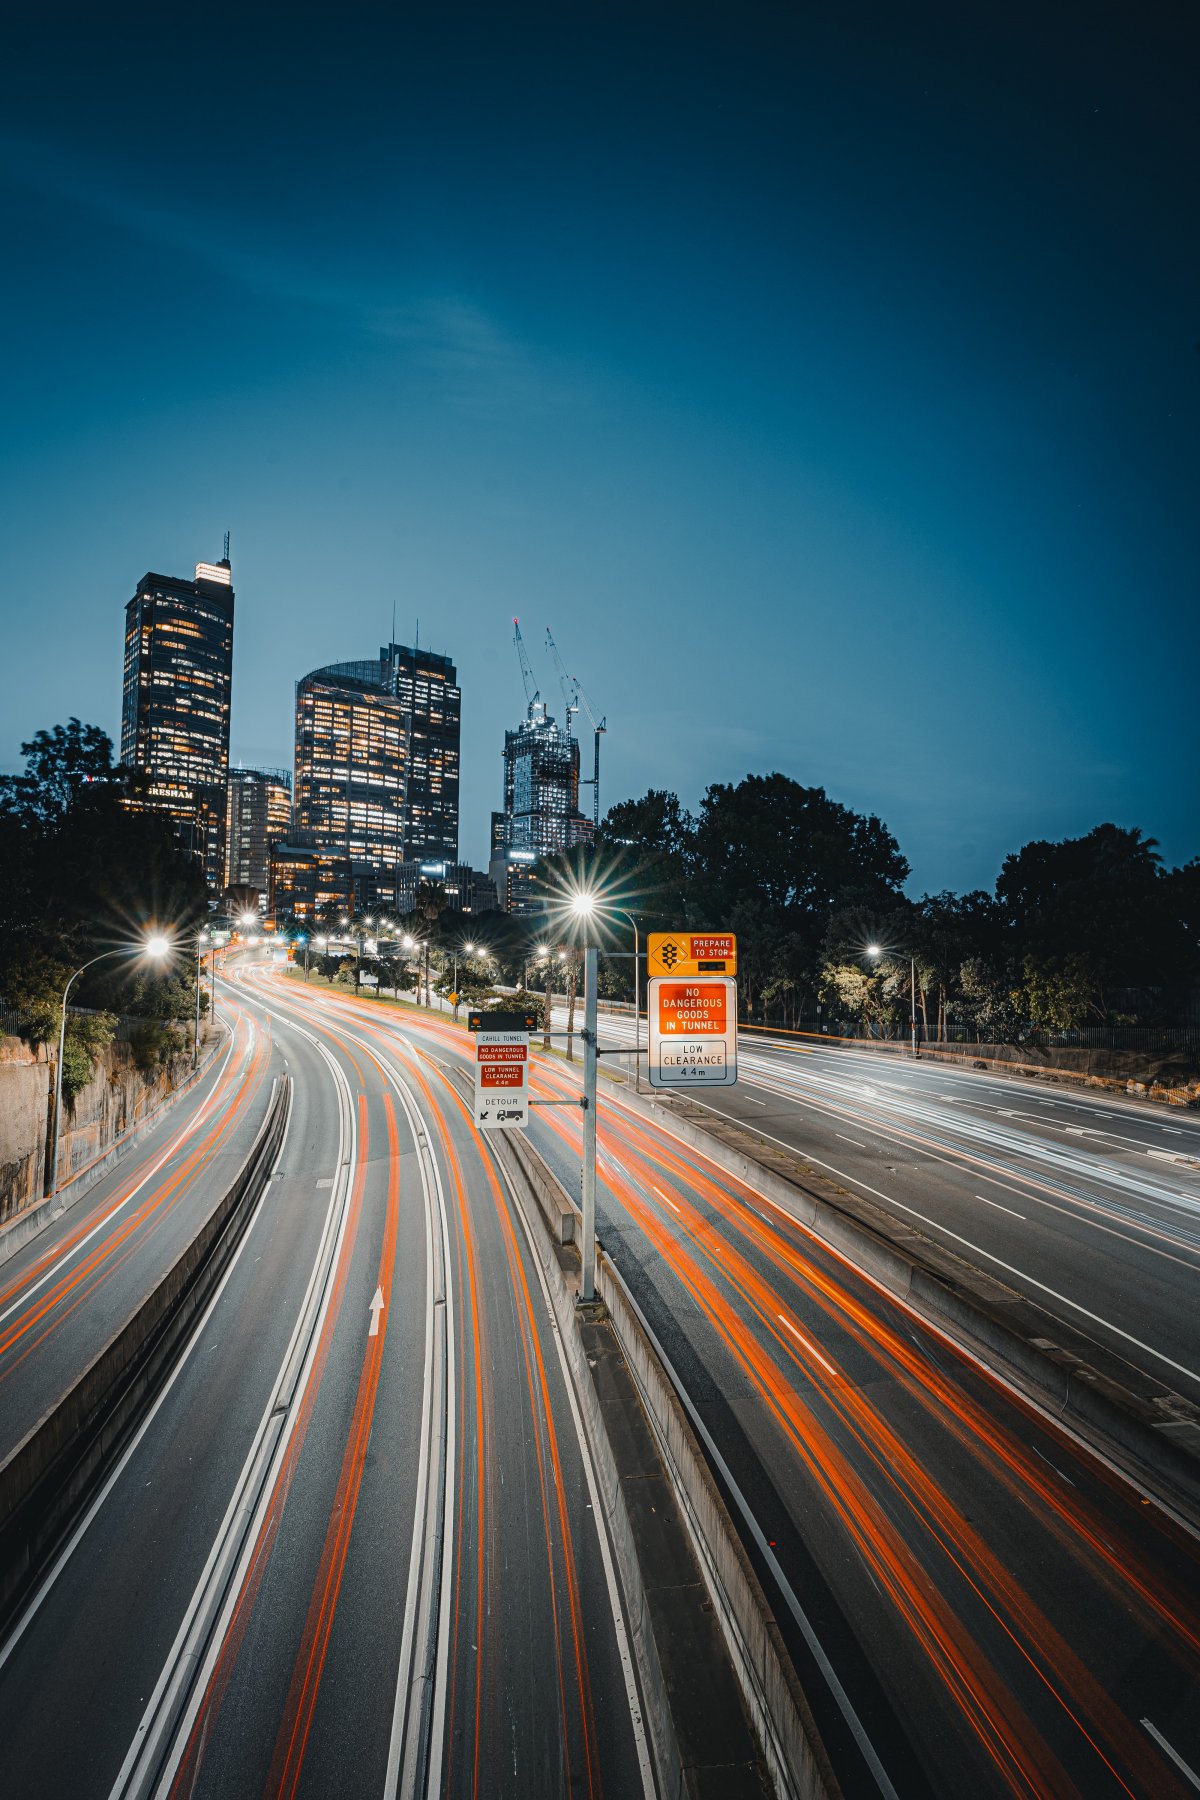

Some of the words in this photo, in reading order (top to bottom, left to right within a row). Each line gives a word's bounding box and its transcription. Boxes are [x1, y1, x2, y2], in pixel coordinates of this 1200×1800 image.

[686, 988, 699, 996] NO
[663, 999, 722, 1008] DANGEROUS
[677, 1010, 709, 1019] GOODS
[666, 1022, 676, 1030] IN
[682, 1021, 719, 1030] TUNNEL
[684, 1045, 703, 1053] LOW
[664, 1056, 722, 1065] CLEARANCE
